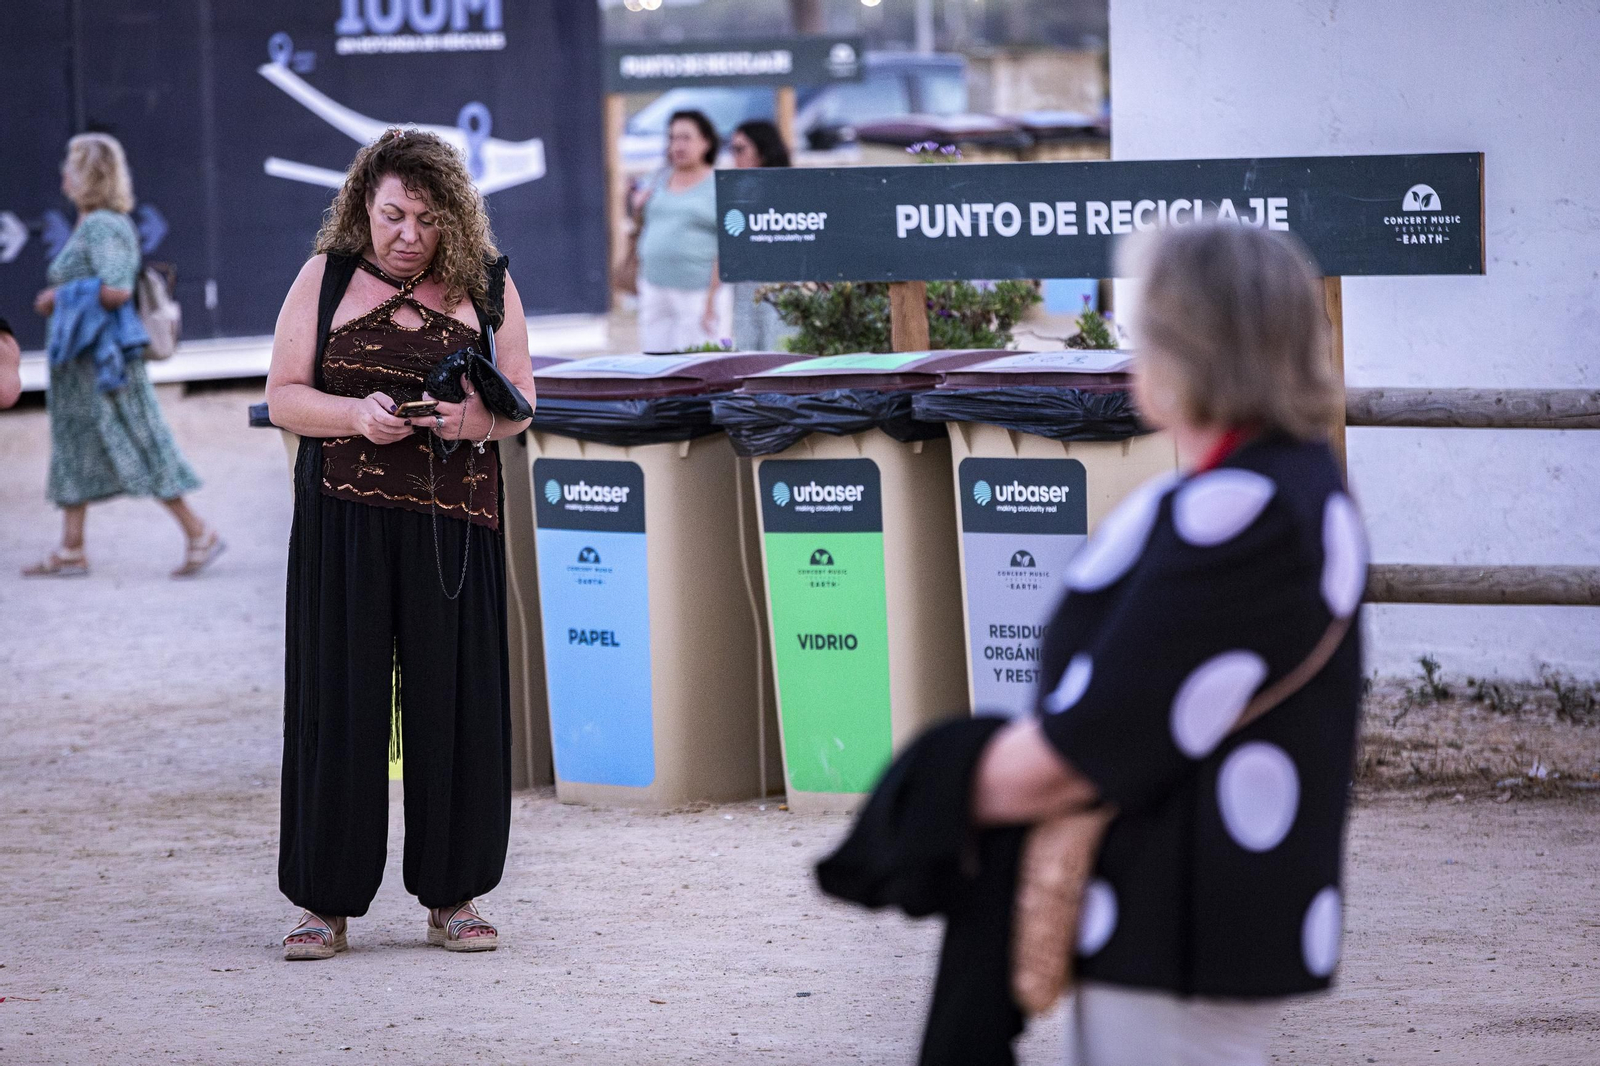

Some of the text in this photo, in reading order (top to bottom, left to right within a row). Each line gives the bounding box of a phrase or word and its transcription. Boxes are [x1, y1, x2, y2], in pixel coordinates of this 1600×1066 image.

[749, 208, 828, 231] urbaser
[896, 202, 1022, 238] PUNTO
[1029, 201, 1078, 236] DE
[1383, 215, 1461, 225] CONCERT MUSIC
[1395, 225, 1450, 233] FESTIVAL
[563, 480, 630, 503] urbaser
[793, 481, 865, 502] urbaser
[995, 480, 1070, 503] urbaser
[996, 504, 1017, 513] making
[1046, 505, 1057, 513] real
[568, 628, 620, 647] PAPEL
[989, 624, 1047, 639] RESIDU
[797, 634, 858, 651] VIDRIO
[984, 642, 1041, 662] ORGÁNI
[993, 668, 1041, 684] Y REST
